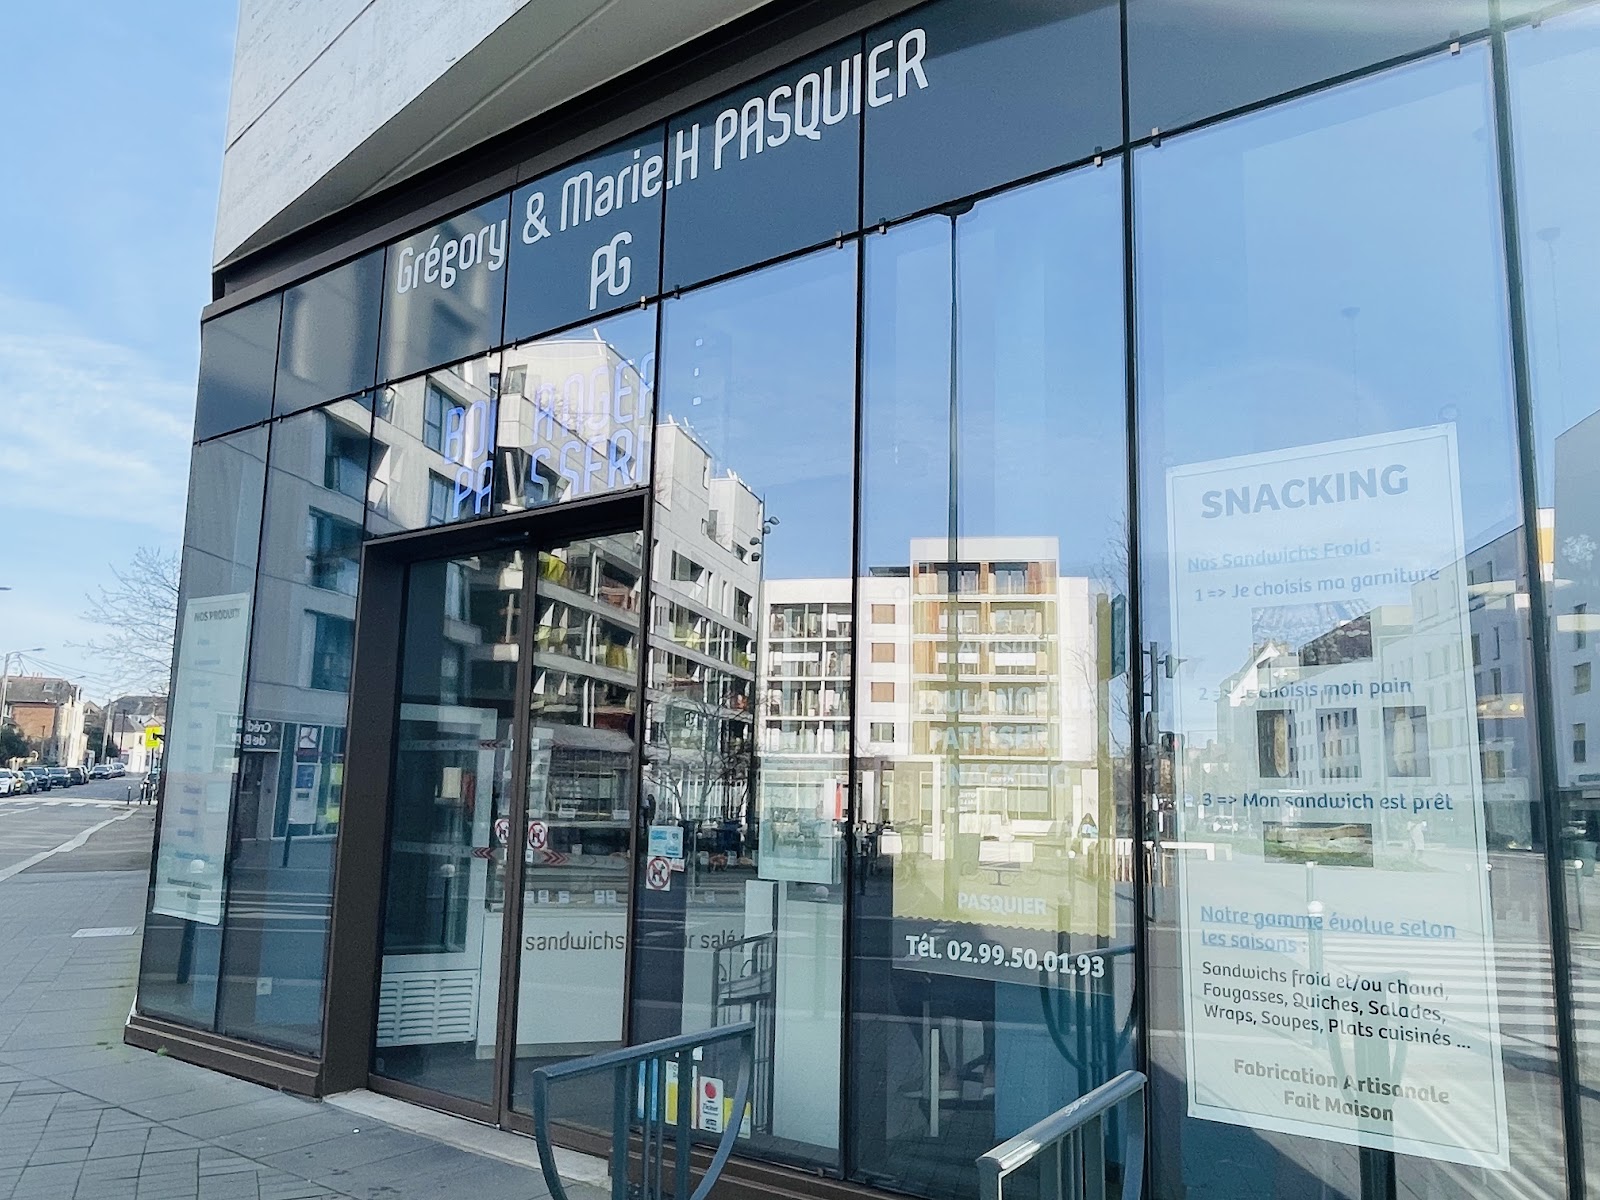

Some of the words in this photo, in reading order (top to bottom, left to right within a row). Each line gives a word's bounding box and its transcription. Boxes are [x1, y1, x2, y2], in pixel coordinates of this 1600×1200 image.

[397, 218, 507, 294] Grégory
[522, 191, 551, 245] &
[714, 28, 929, 170] PASQUIER
[589, 232, 633, 310] PG
[1201, 464, 1409, 518] SNACKING
[1188, 556, 1218, 572] Nos
[1222, 545, 1318, 569] Sandwichs
[1325, 539, 1371, 558] Froid
[1195, 588, 1203, 602] 1
[1231, 583, 1250, 599] Je
[1254, 577, 1312, 597] choisis
[1317, 576, 1345, 592] ma
[1351, 567, 1440, 594] garniture
[1199, 688, 1208, 701] 2
[1323, 680, 1363, 697] mon
[1370, 678, 1412, 702] pain
[1203, 793, 1212, 806] 3
[1243, 793, 1280, 808] Mon
[1285, 793, 1373, 809] sandwich
[1380, 795, 1407, 810] est
[1413, 793, 1453, 813] prêt
[958, 892, 1047, 916] PASQUIER
[1201, 905, 1249, 925] Notre
[1254, 912, 1322, 933] gamme
[1329, 912, 1395, 933] évolue
[1400, 917, 1456, 939] selon
[525, 930, 625, 951] sandwichs
[905, 933, 942, 959] Tél.
[947, 940, 1105, 978] 02.99.50.01.93
[1201, 929, 1226, 947] les
[1230, 932, 1297, 952] saisons
[1202, 960, 1287, 983] Sandwichs
[1292, 968, 1330, 989] froid
[1336, 972, 1382, 994] et/ou
[1388, 979, 1450, 1001] chaud,
[1203, 982, 1288, 1008] Fougasses,
[1293, 991, 1363, 1017] Quiches,
[1368, 1000, 1447, 1024] Salades,
[1204, 1003, 1257, 1026] Wraps,
[1261, 1010, 1324, 1035] Soupes,
[1329, 1018, 1373, 1039] Plats
[1378, 1024, 1451, 1047] cuisinés
[1233, 1058, 1338, 1090] Fabrication
[1343, 1073, 1450, 1106] Artisanale
[1284, 1090, 1320, 1111] Fait
[1324, 1096, 1395, 1123] Maison
